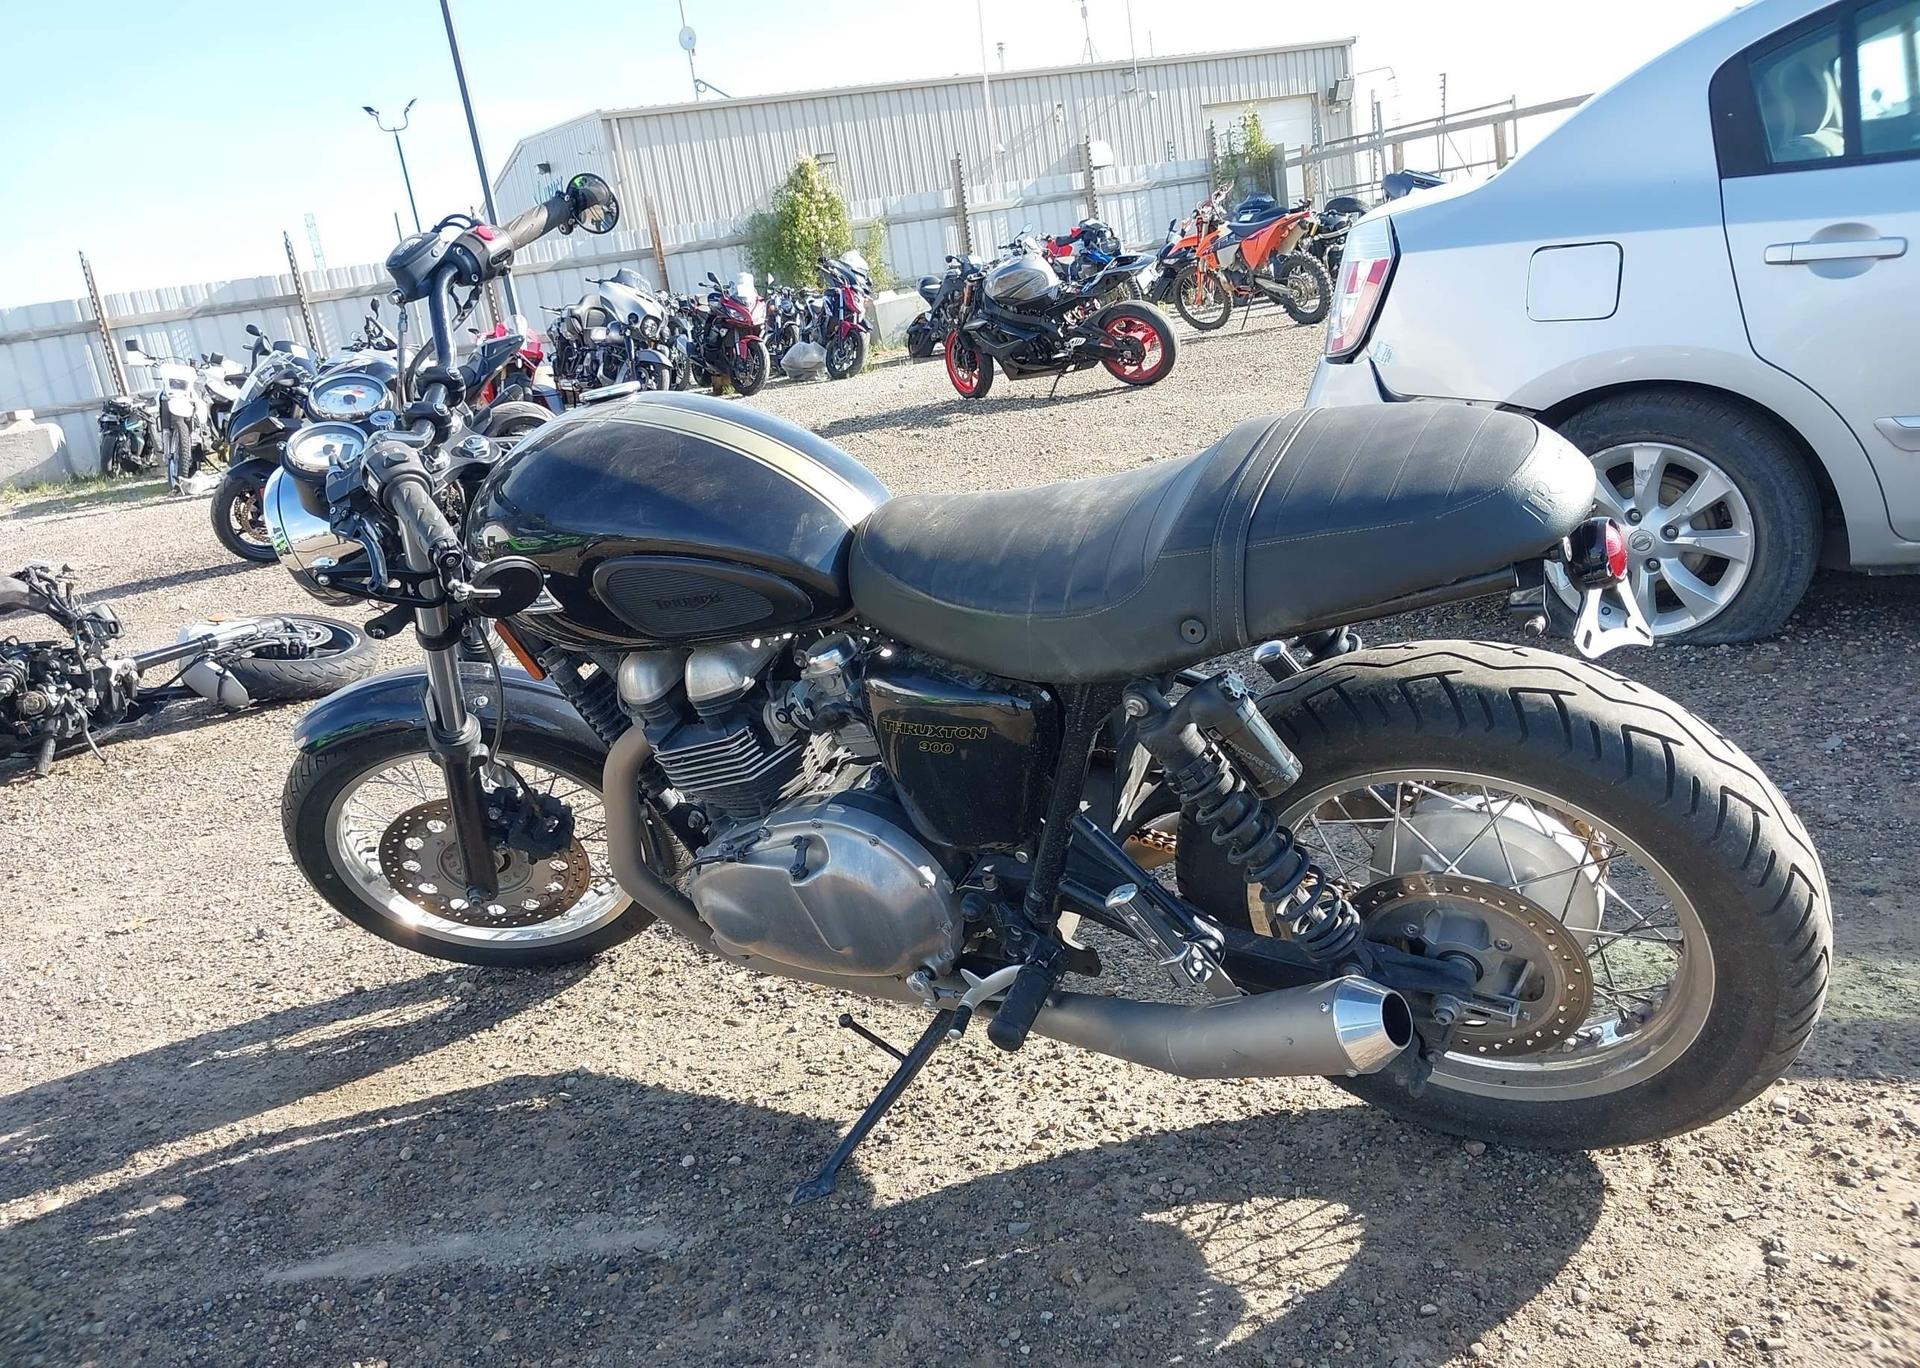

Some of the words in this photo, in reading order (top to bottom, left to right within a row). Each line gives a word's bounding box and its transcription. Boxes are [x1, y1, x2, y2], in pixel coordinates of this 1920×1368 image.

[883, 719, 988, 740] THRUXTON
[918, 740, 955, 755] 900
[1224, 738, 1291, 782] PROGRESSIVE
